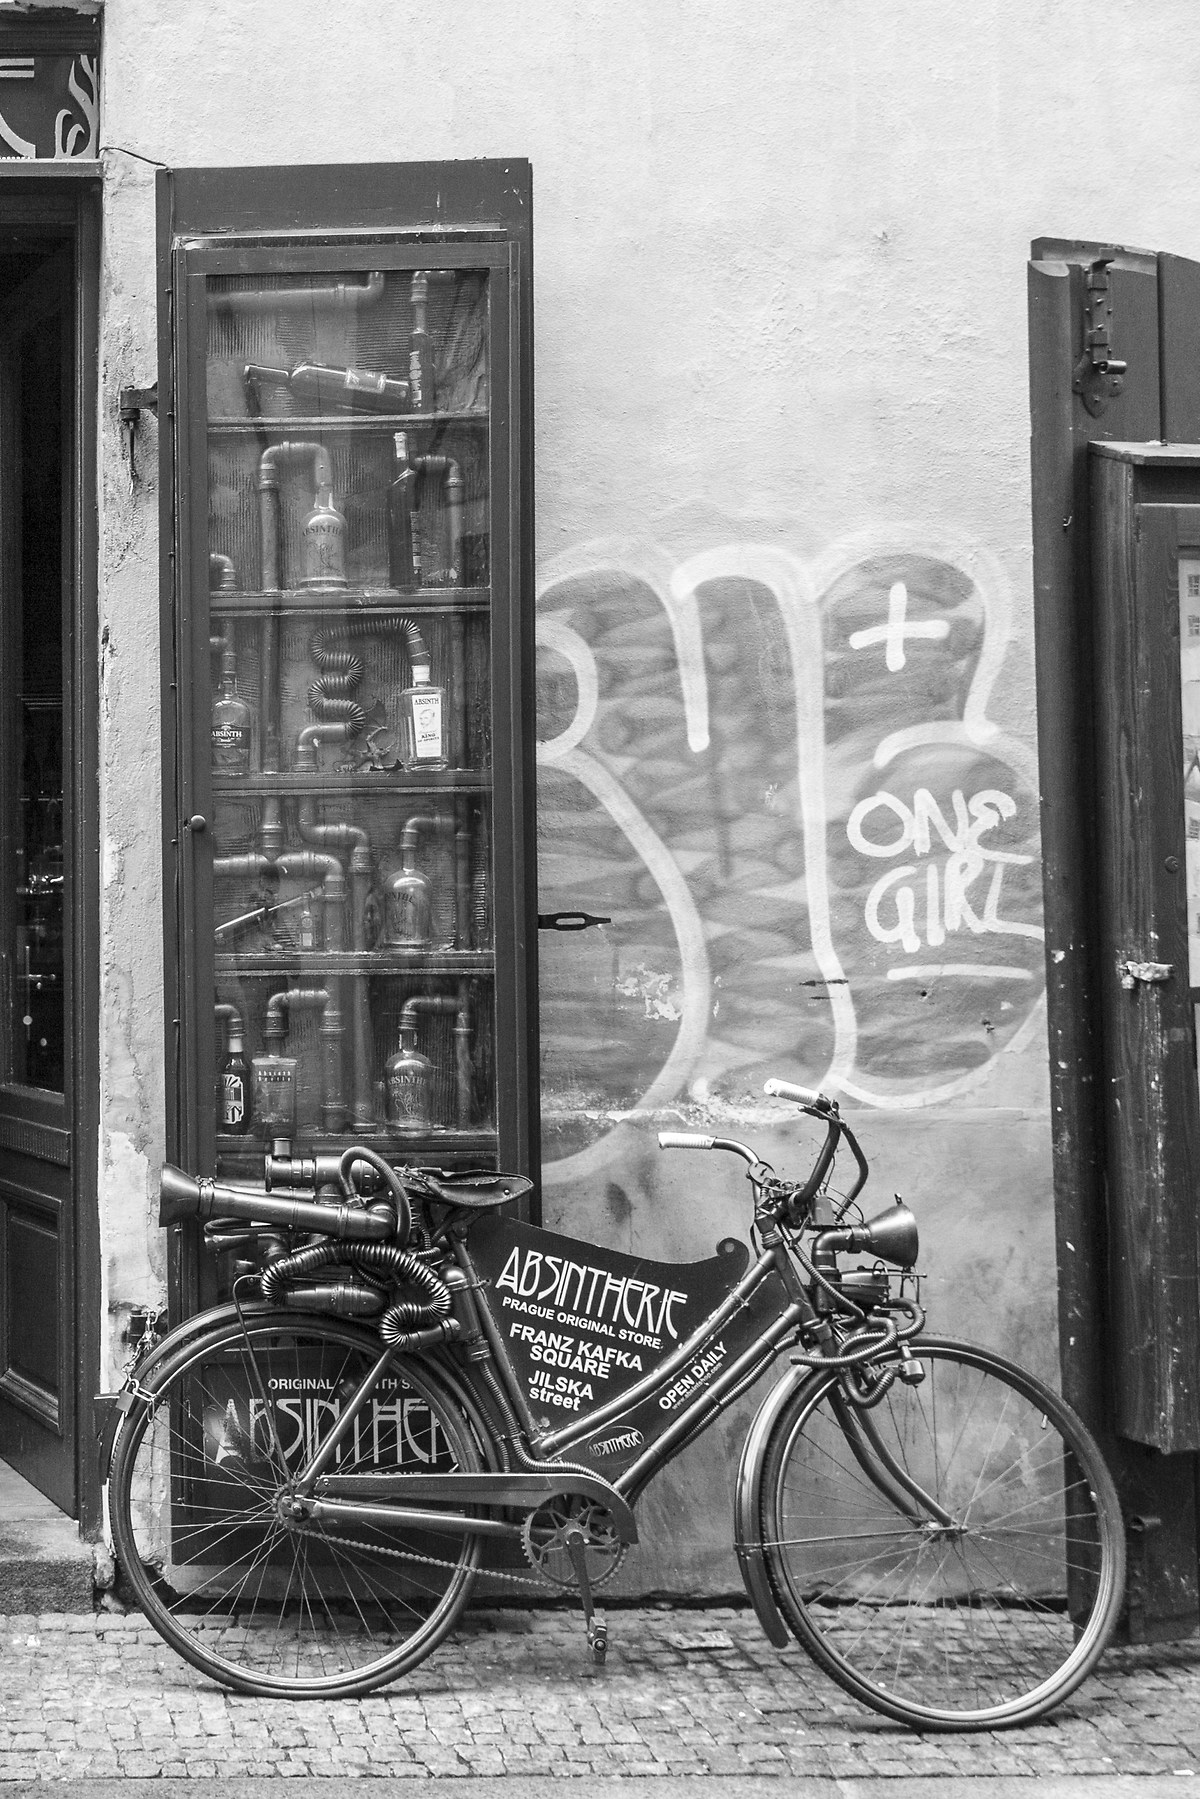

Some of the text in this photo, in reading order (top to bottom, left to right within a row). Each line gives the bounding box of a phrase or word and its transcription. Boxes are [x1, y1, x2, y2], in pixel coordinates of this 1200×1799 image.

[413, 697, 440, 705] ABSINTH
[211, 730, 243, 738] ABSINTH
[847, 787, 1036, 866] ONE
[495, 1246, 689, 1340] ABSINTHERIE
[502, 1296, 663, 1350] PRAGUE ORIGINAL STORE
[509, 1322, 643, 1372] FRANZ KAFKA
[529, 1345, 611, 1380] SQUARE
[267, 1378, 335, 1391] ORIGINAL
[528, 1370, 594, 1400] JILSKA
[658, 1340, 728, 1410] OPEN DAILY
[529, 1387, 581, 1412] street
